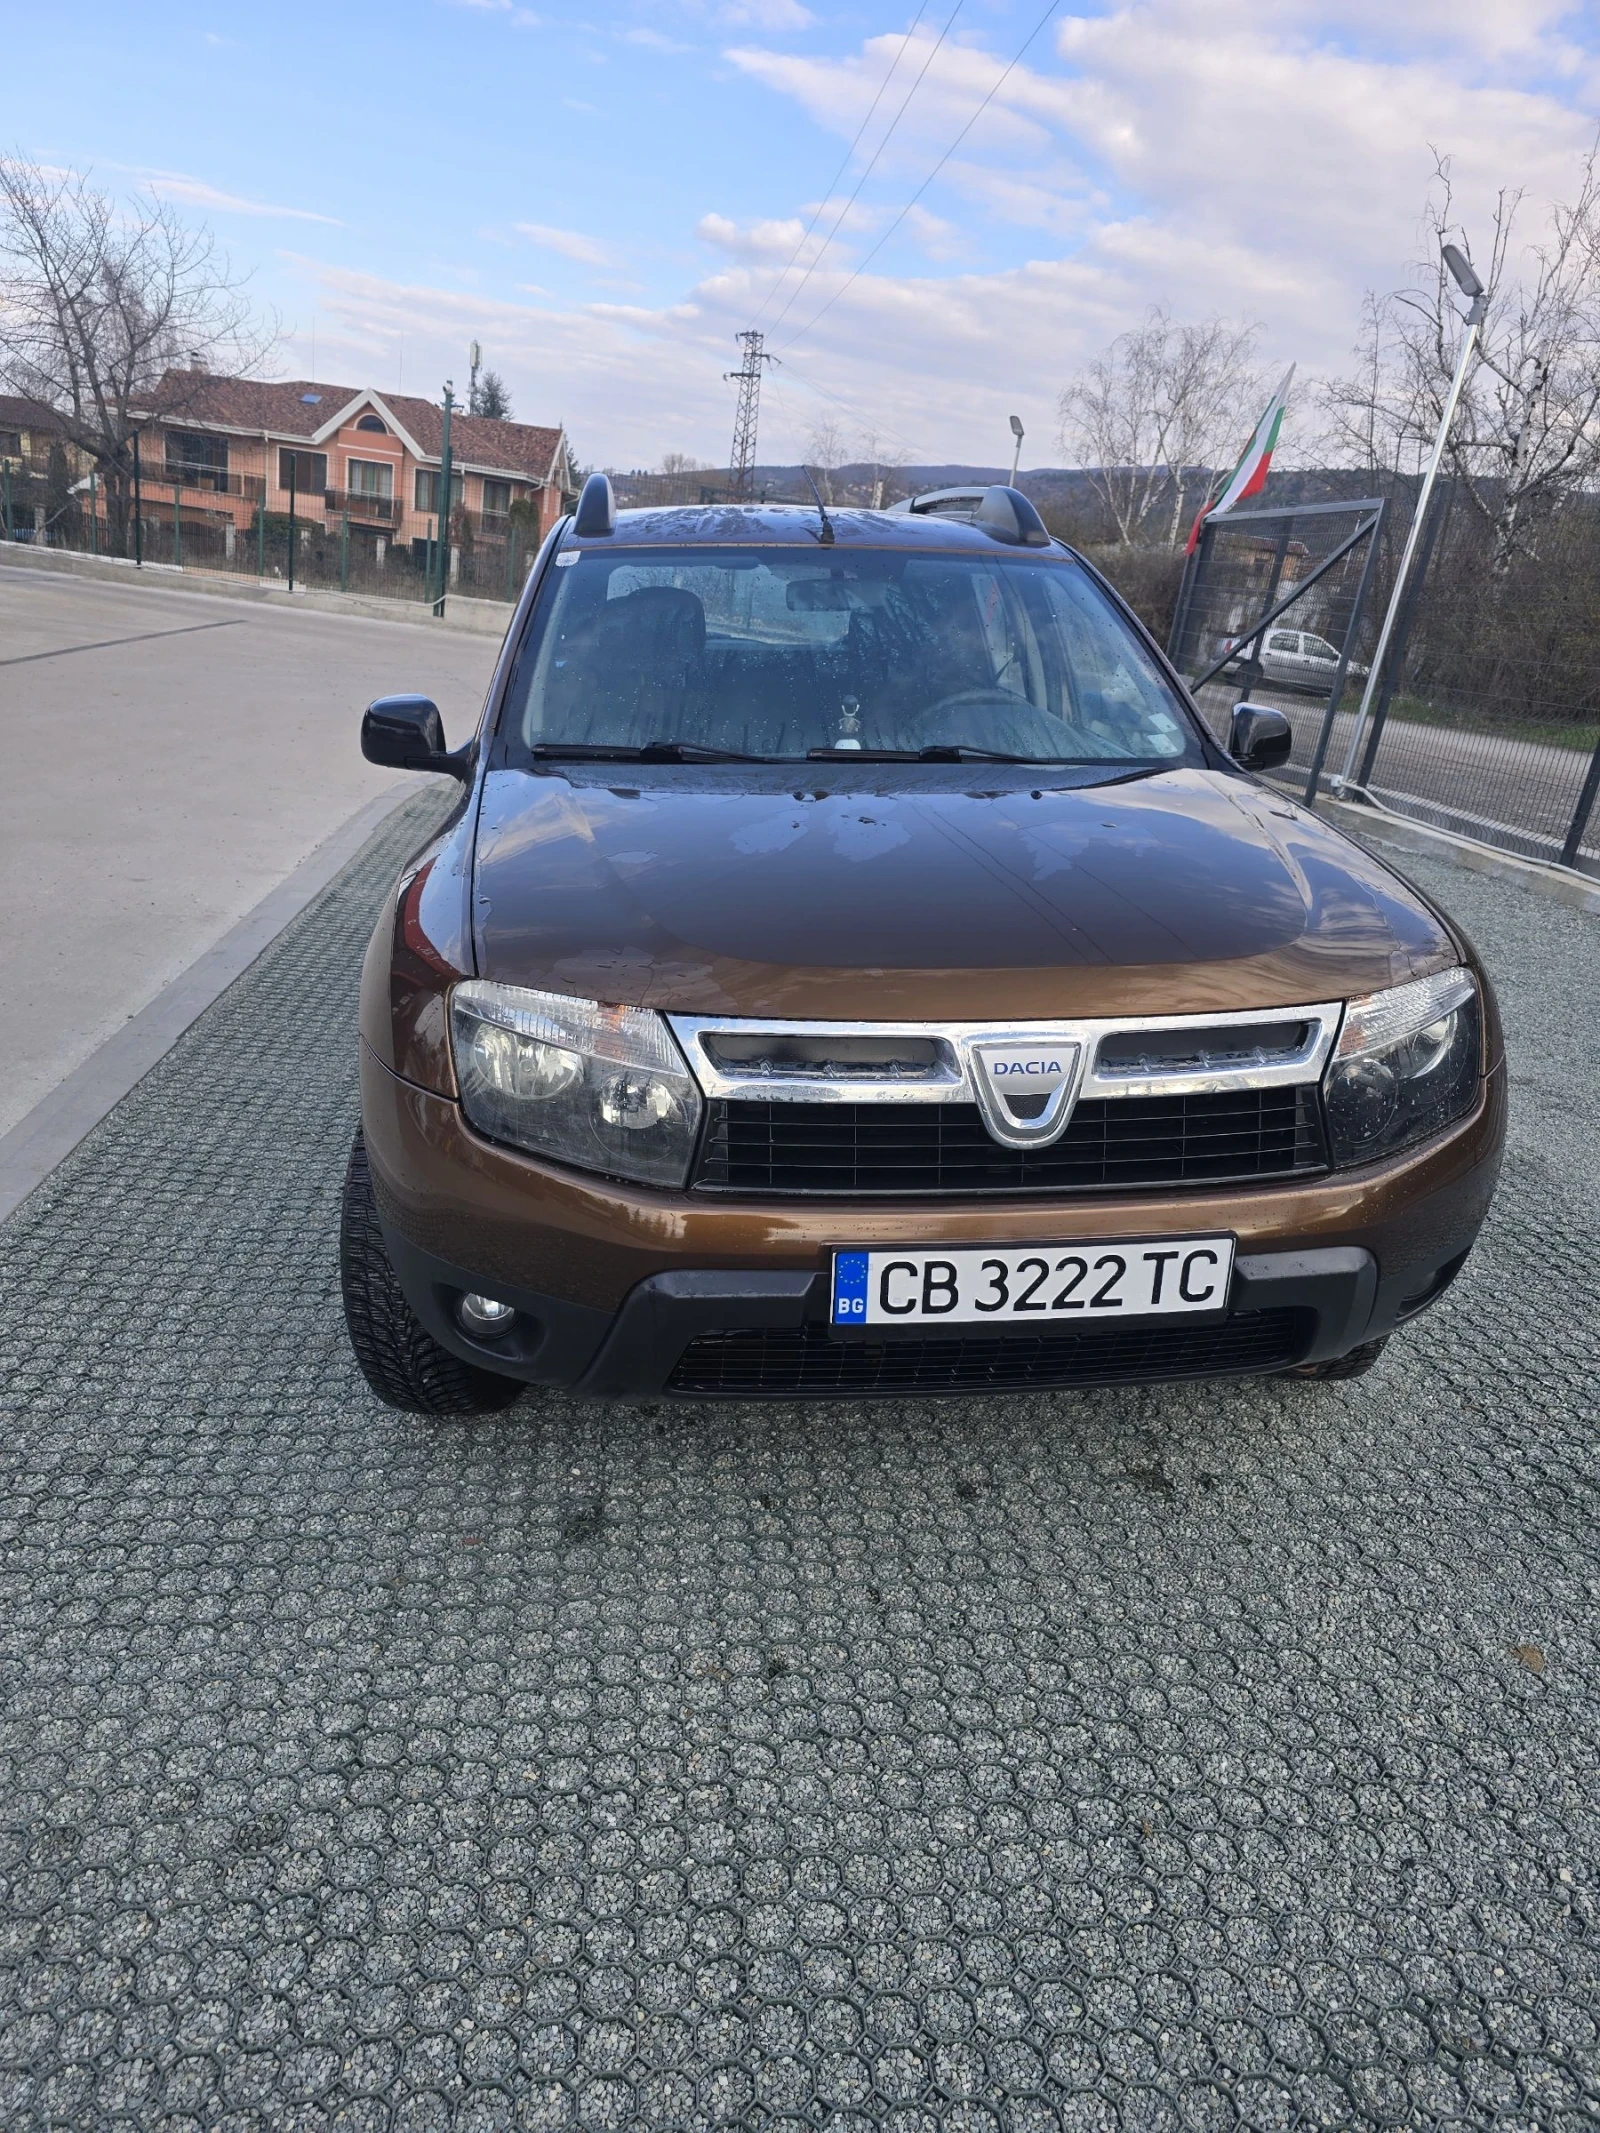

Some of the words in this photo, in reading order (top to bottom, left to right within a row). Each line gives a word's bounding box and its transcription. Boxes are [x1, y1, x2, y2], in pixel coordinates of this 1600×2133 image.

[994, 1061, 1062, 1075] DACIA
[879, 1260, 959, 1315] CB
[974, 1254, 1127, 1312] 3222
[1143, 1250, 1218, 1305] TC
[838, 1298, 864, 1315] BG
